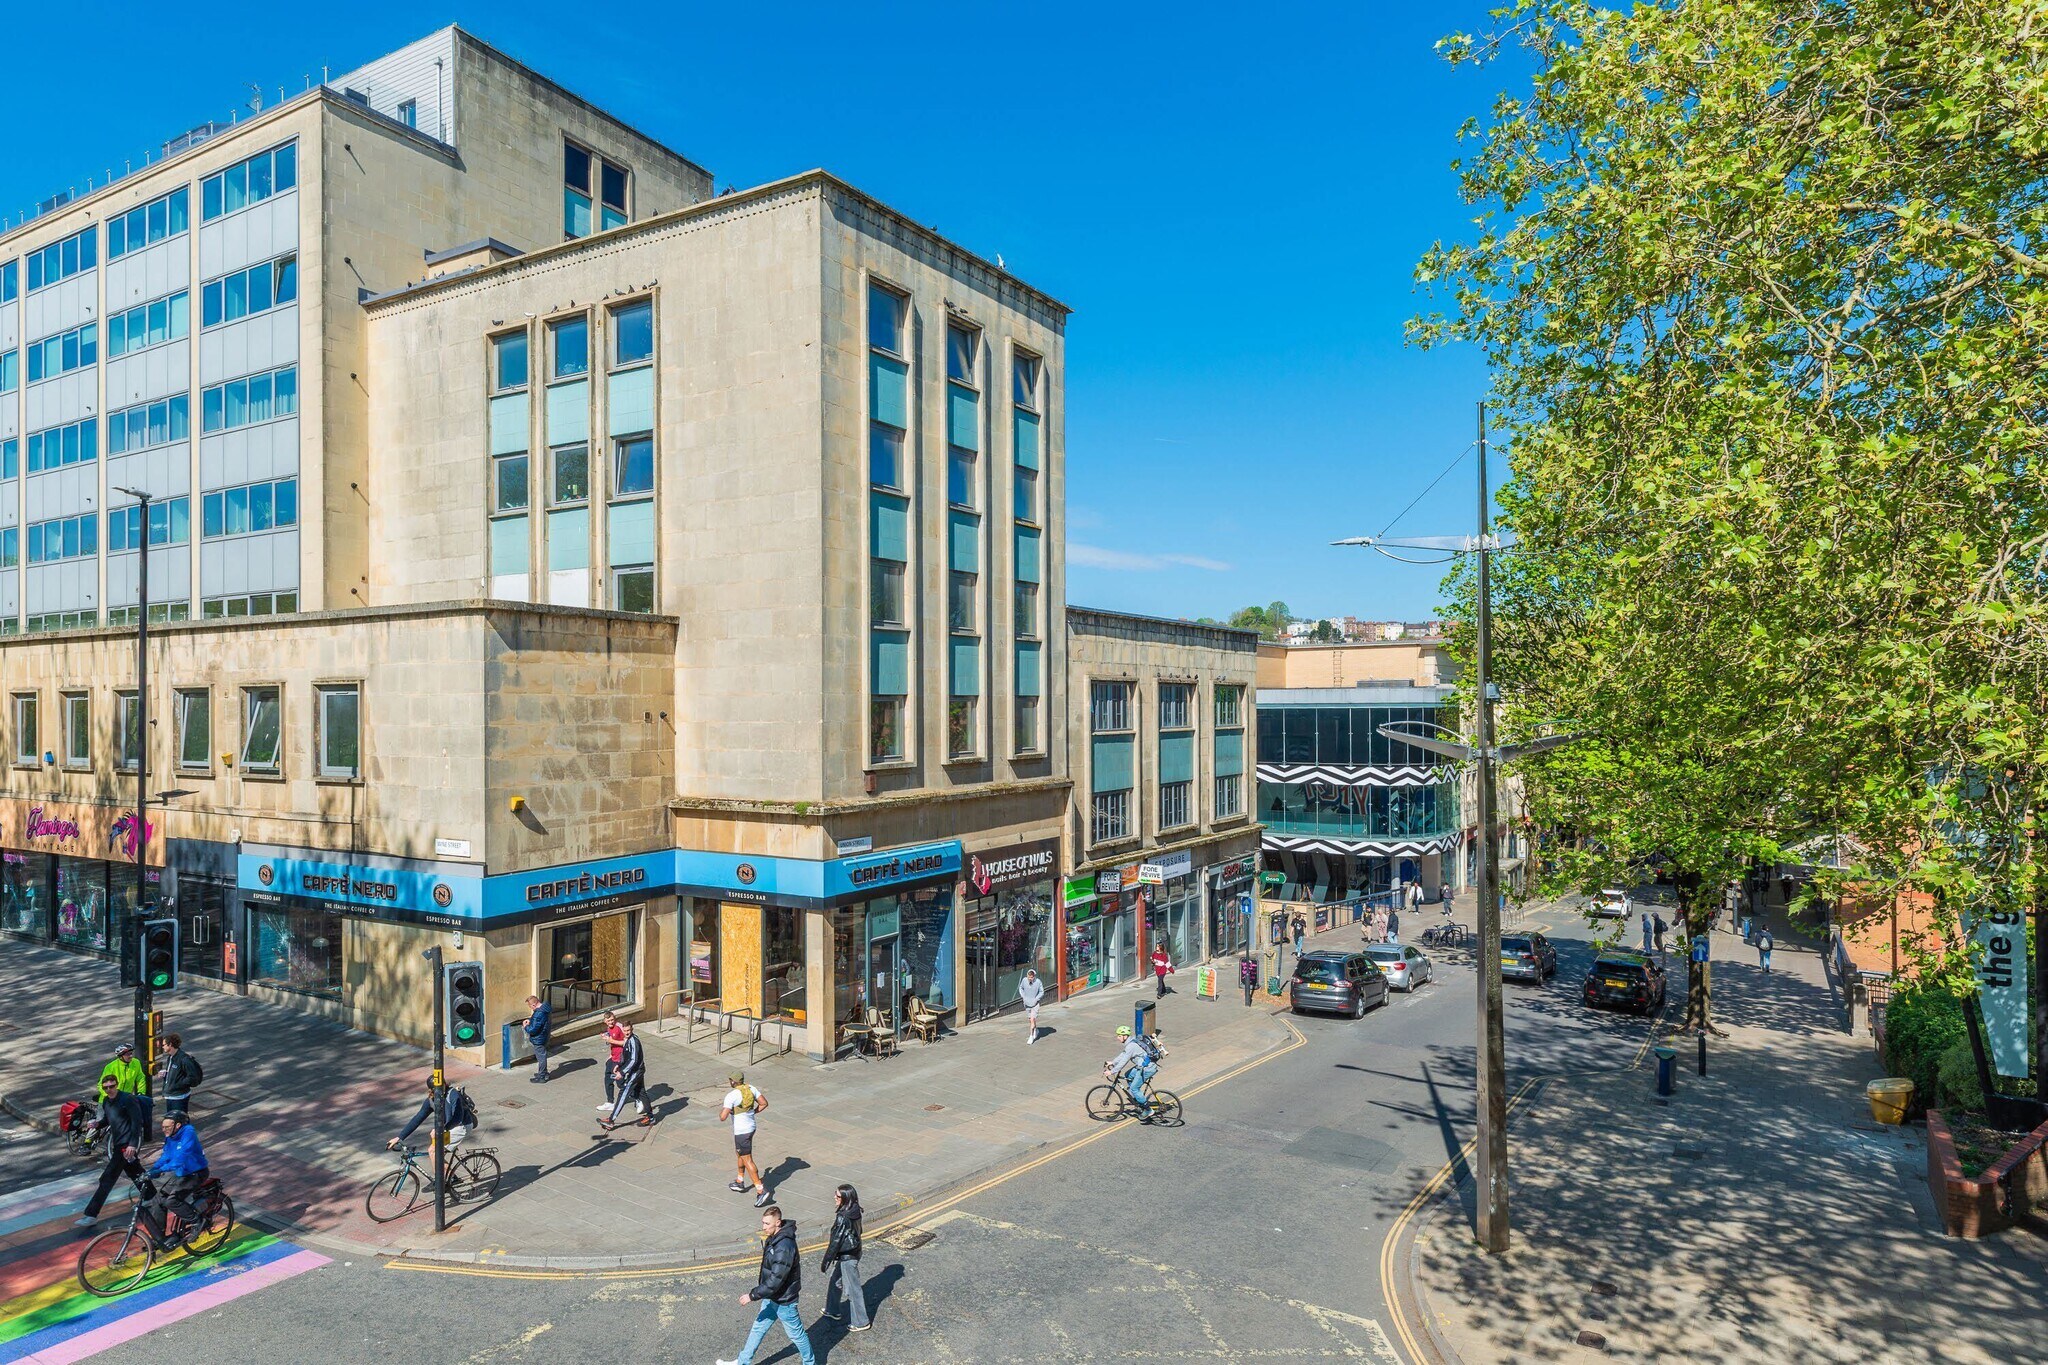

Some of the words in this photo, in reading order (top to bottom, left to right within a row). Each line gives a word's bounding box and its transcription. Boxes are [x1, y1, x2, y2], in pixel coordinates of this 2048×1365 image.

[26, 806, 80, 842] Flamingo's
[30, 843, 75, 853] VINTAGE
[852, 858, 900, 884] CAFFÈ
[904, 854, 942, 875] NERO
[986, 858, 1016, 877] HOUSE
[991, 875, 1007, 884] nails
[1008, 872, 1021, 880] hair
[1027, 866, 1048, 876] beauty
[352, 880, 398, 901] NERO
[526, 871, 590, 901] CAFFÈ
[593, 868, 645, 891] NERO
[1101, 882, 1119, 891] REVIVE
[253, 893, 273, 901] ESPRESSO
[728, 891, 754, 900] ESPRESSO
[333, 903, 350, 911] ITALIAN
[351, 905, 367, 914] COFFEE
[567, 903, 589, 912] ITALIAN
[590, 898, 610, 908] COFFEE
[426, 915, 450, 924] ESPRESSO
[1982, 936, 2012, 988] the
